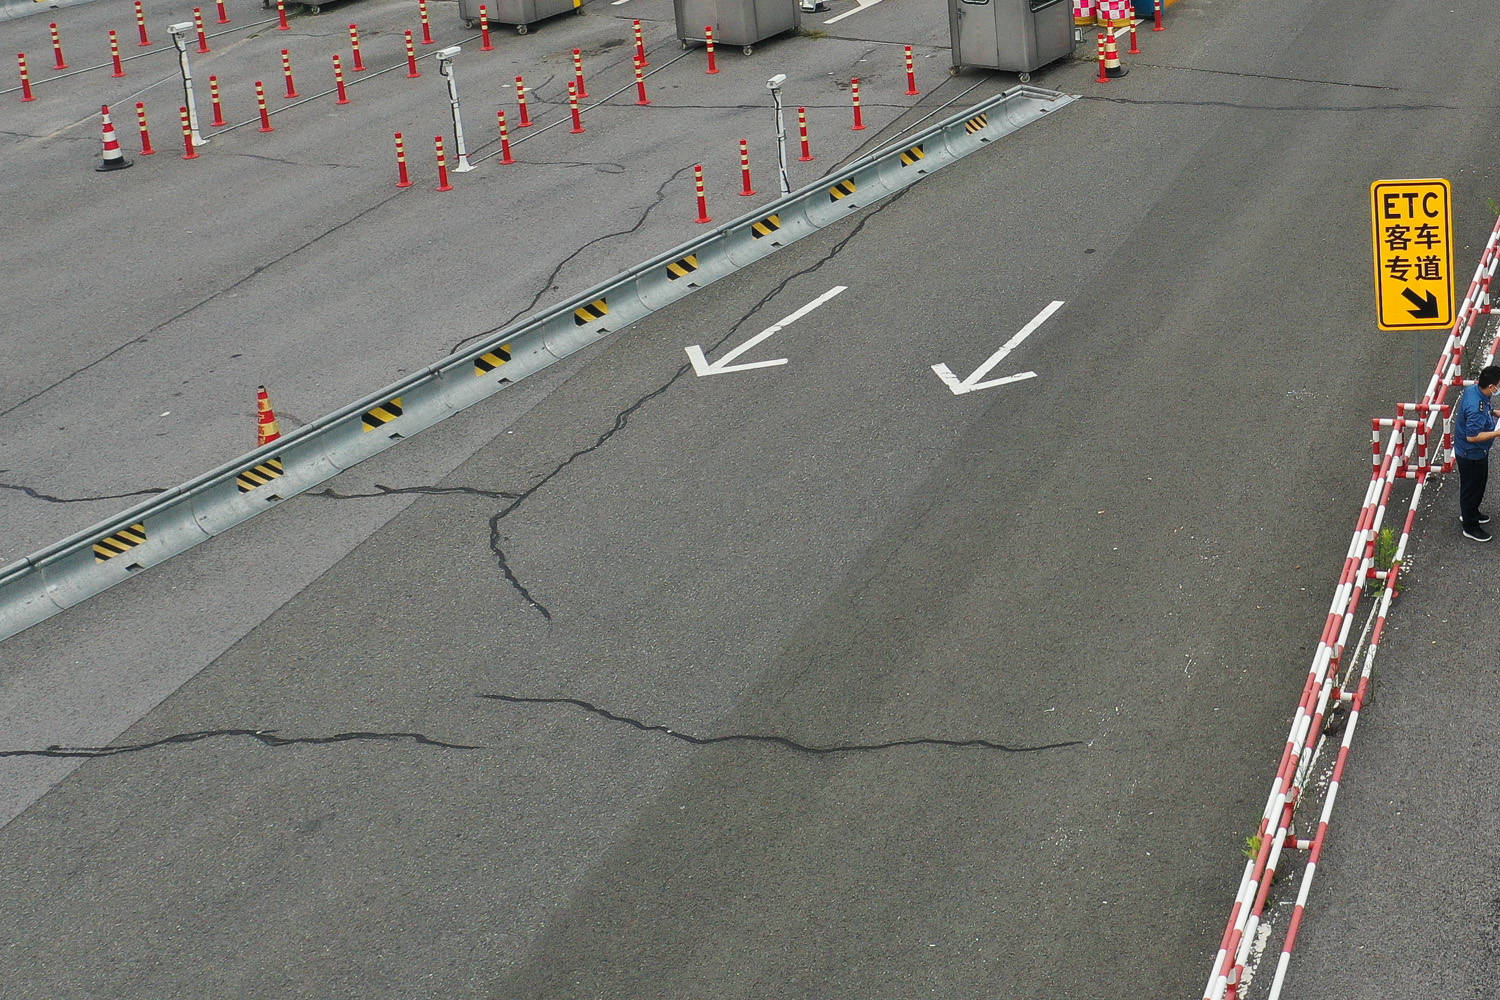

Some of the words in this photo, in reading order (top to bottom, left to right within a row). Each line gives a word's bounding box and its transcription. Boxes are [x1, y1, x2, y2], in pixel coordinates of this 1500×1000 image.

[1384, 192, 1439, 219] ETC
[1385, 223, 1441, 251] 客车
[1385, 255, 1443, 282] 专道
